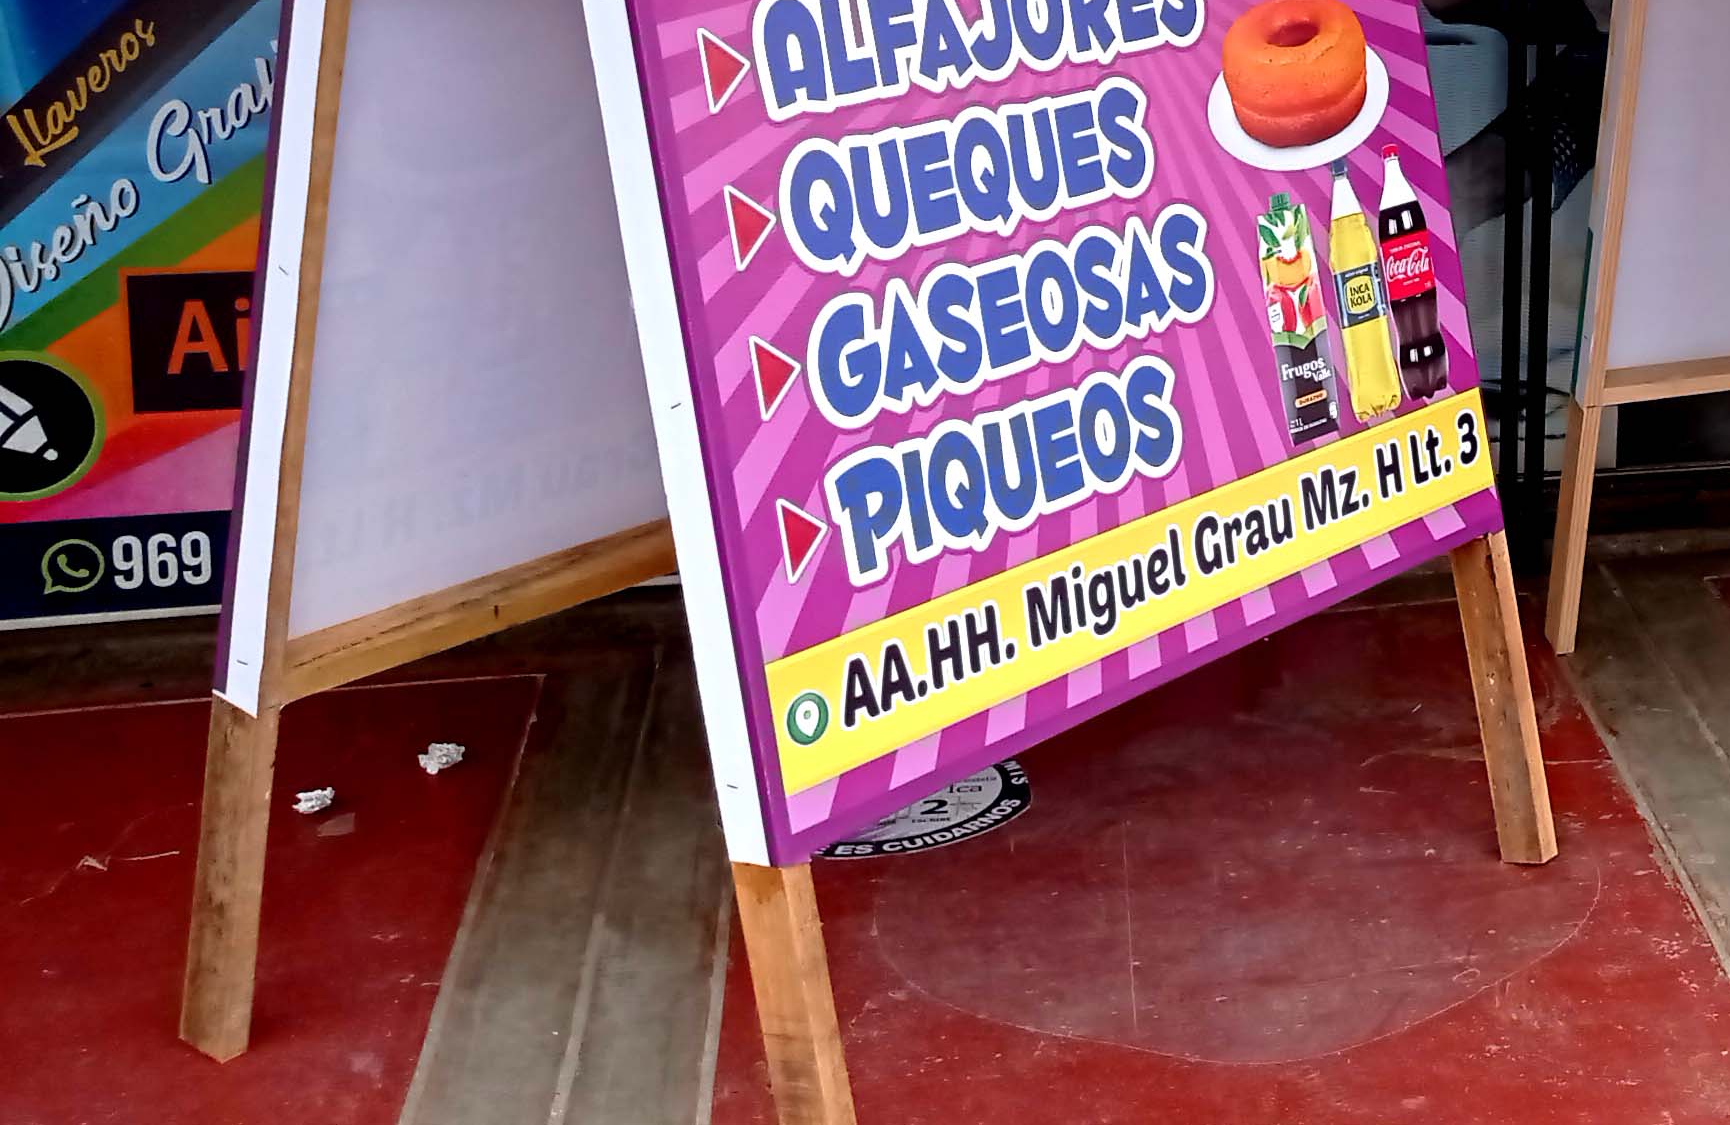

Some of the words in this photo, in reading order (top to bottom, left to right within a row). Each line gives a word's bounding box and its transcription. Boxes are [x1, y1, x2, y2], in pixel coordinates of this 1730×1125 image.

[787, 85, 1147, 268] QUEQUES
[815, 212, 1209, 419] GASEOSAS
[1350, 283, 1370, 296] INCA
[1350, 293, 1373, 308] KOLA
[167, 297, 251, 375] Ai
[1282, 357, 1325, 382] Frugos
[834, 364, 1177, 577] PIQUEOS
[111, 530, 213, 591] 969
[842, 604, 1016, 728] AA.HH.
[1027, 532, 1187, 647] Miguel
[1199, 501, 1294, 571] Grau
[1302, 469, 1371, 530] Mz.
[1377, 445, 1401, 500] H
[1409, 429, 1451, 484] Lt.
[1459, 411, 1480, 464] 3
[834, 842, 874, 856] ES
[882, 798, 1022, 852] CUIDARNOS
[920, 799, 949, 816] 2
